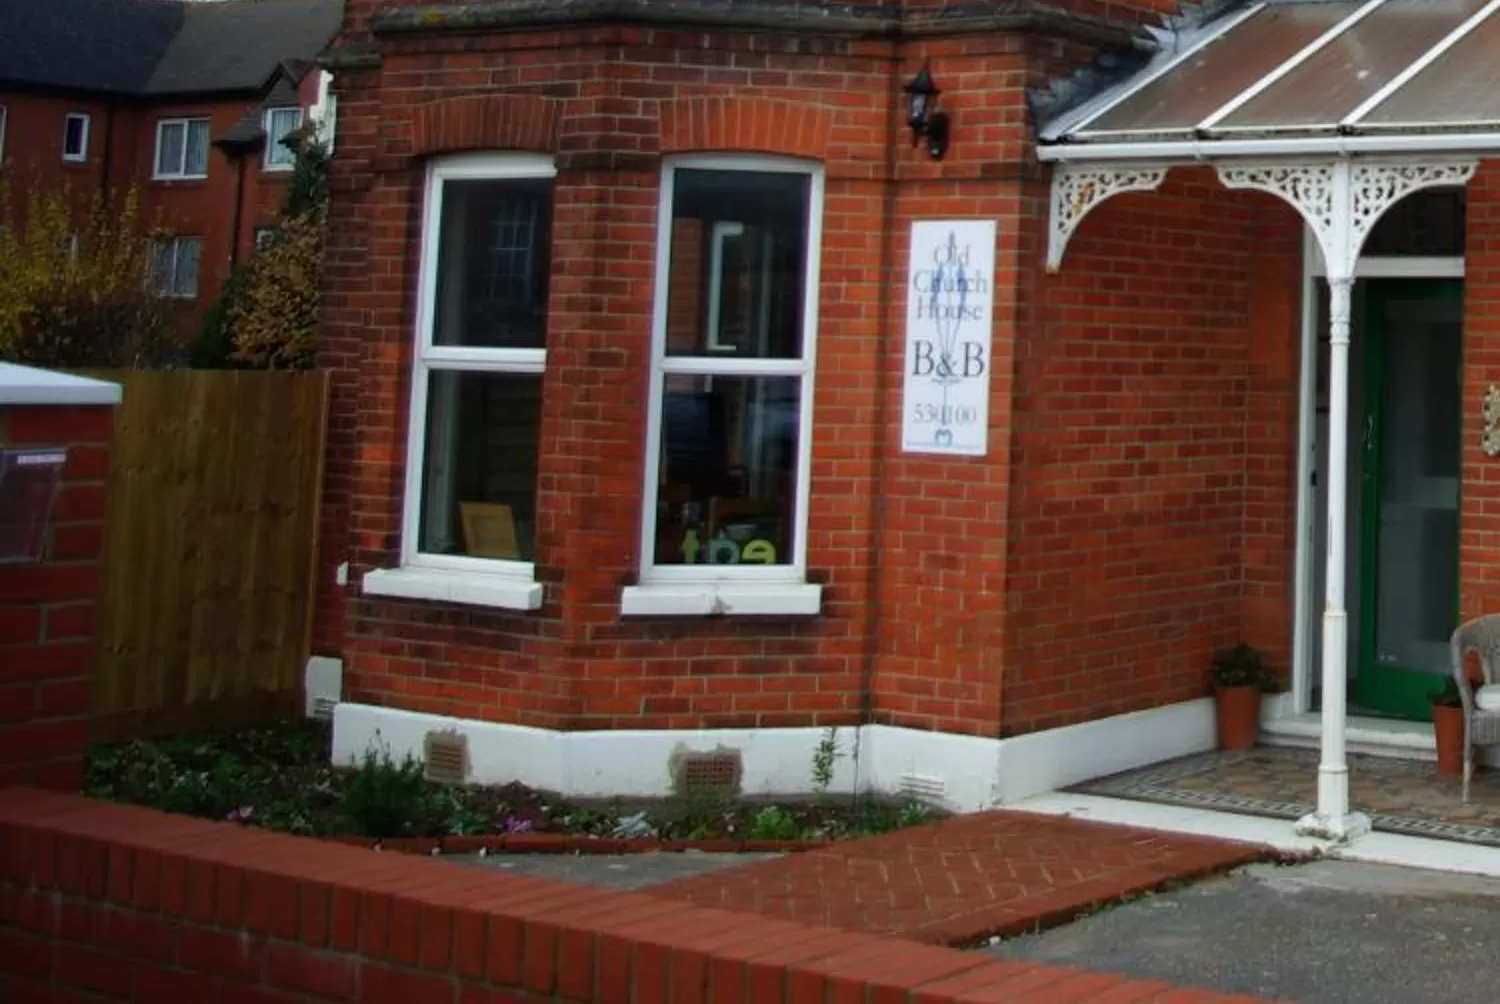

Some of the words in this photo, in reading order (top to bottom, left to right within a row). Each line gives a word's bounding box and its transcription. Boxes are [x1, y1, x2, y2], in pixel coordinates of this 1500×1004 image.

[933, 242, 970, 267] Old
[912, 269, 988, 293] Church
[916, 295, 984, 321] House
[912, 339, 985, 378] B&B
